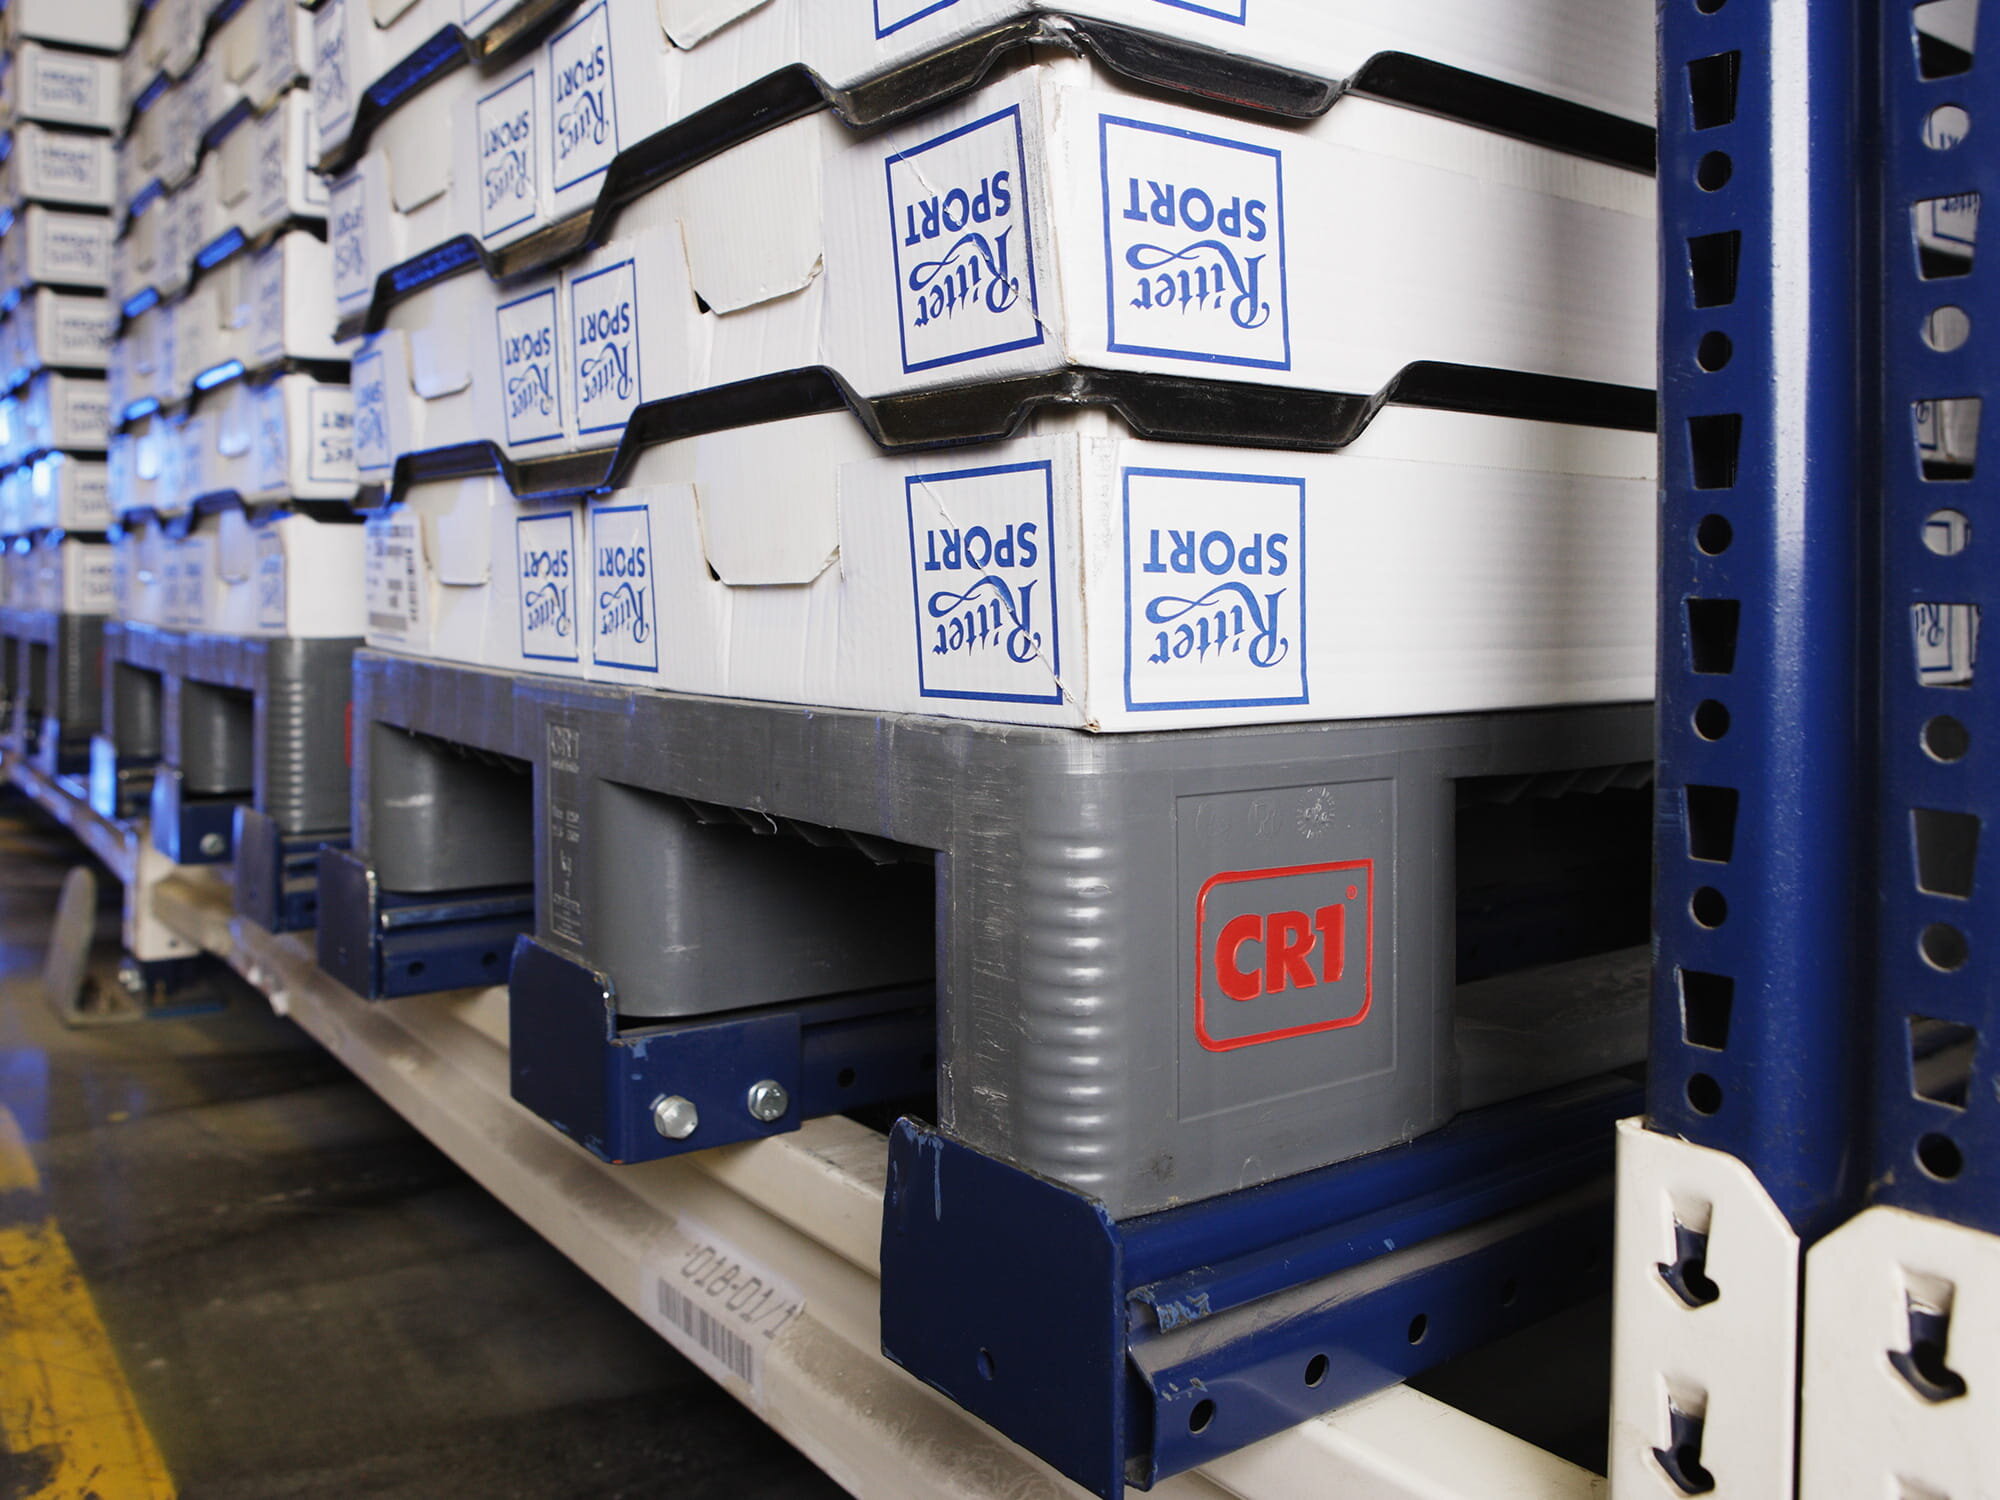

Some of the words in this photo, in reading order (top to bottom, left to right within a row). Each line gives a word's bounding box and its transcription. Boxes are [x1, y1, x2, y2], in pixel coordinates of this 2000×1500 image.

[556, 45, 605, 103] SPORT
[484, 110, 530, 158] SPORT
[905, 170, 1011, 247] SPORT
[1123, 177, 1267, 242] SPORT
[909, 224, 1019, 328] Ritter
[1125, 239, 1270, 329] Ritter
[505, 327, 551, 366] SPORT
[580, 302, 631, 346] SPORT
[581, 341, 634, 404] Ritter
[523, 548, 569, 578] SPORT
[599, 546, 646, 578] SPORT
[924, 521, 1038, 572] SPORT
[1143, 529, 1289, 577] SPORT
[525, 582, 572, 638] Ritter
[600, 581, 650, 645] Ritter
[927, 574, 1041, 664] Ritter
[1145, 581, 1289, 669] Ritter
[1214, 902, 1345, 1001] CR1
